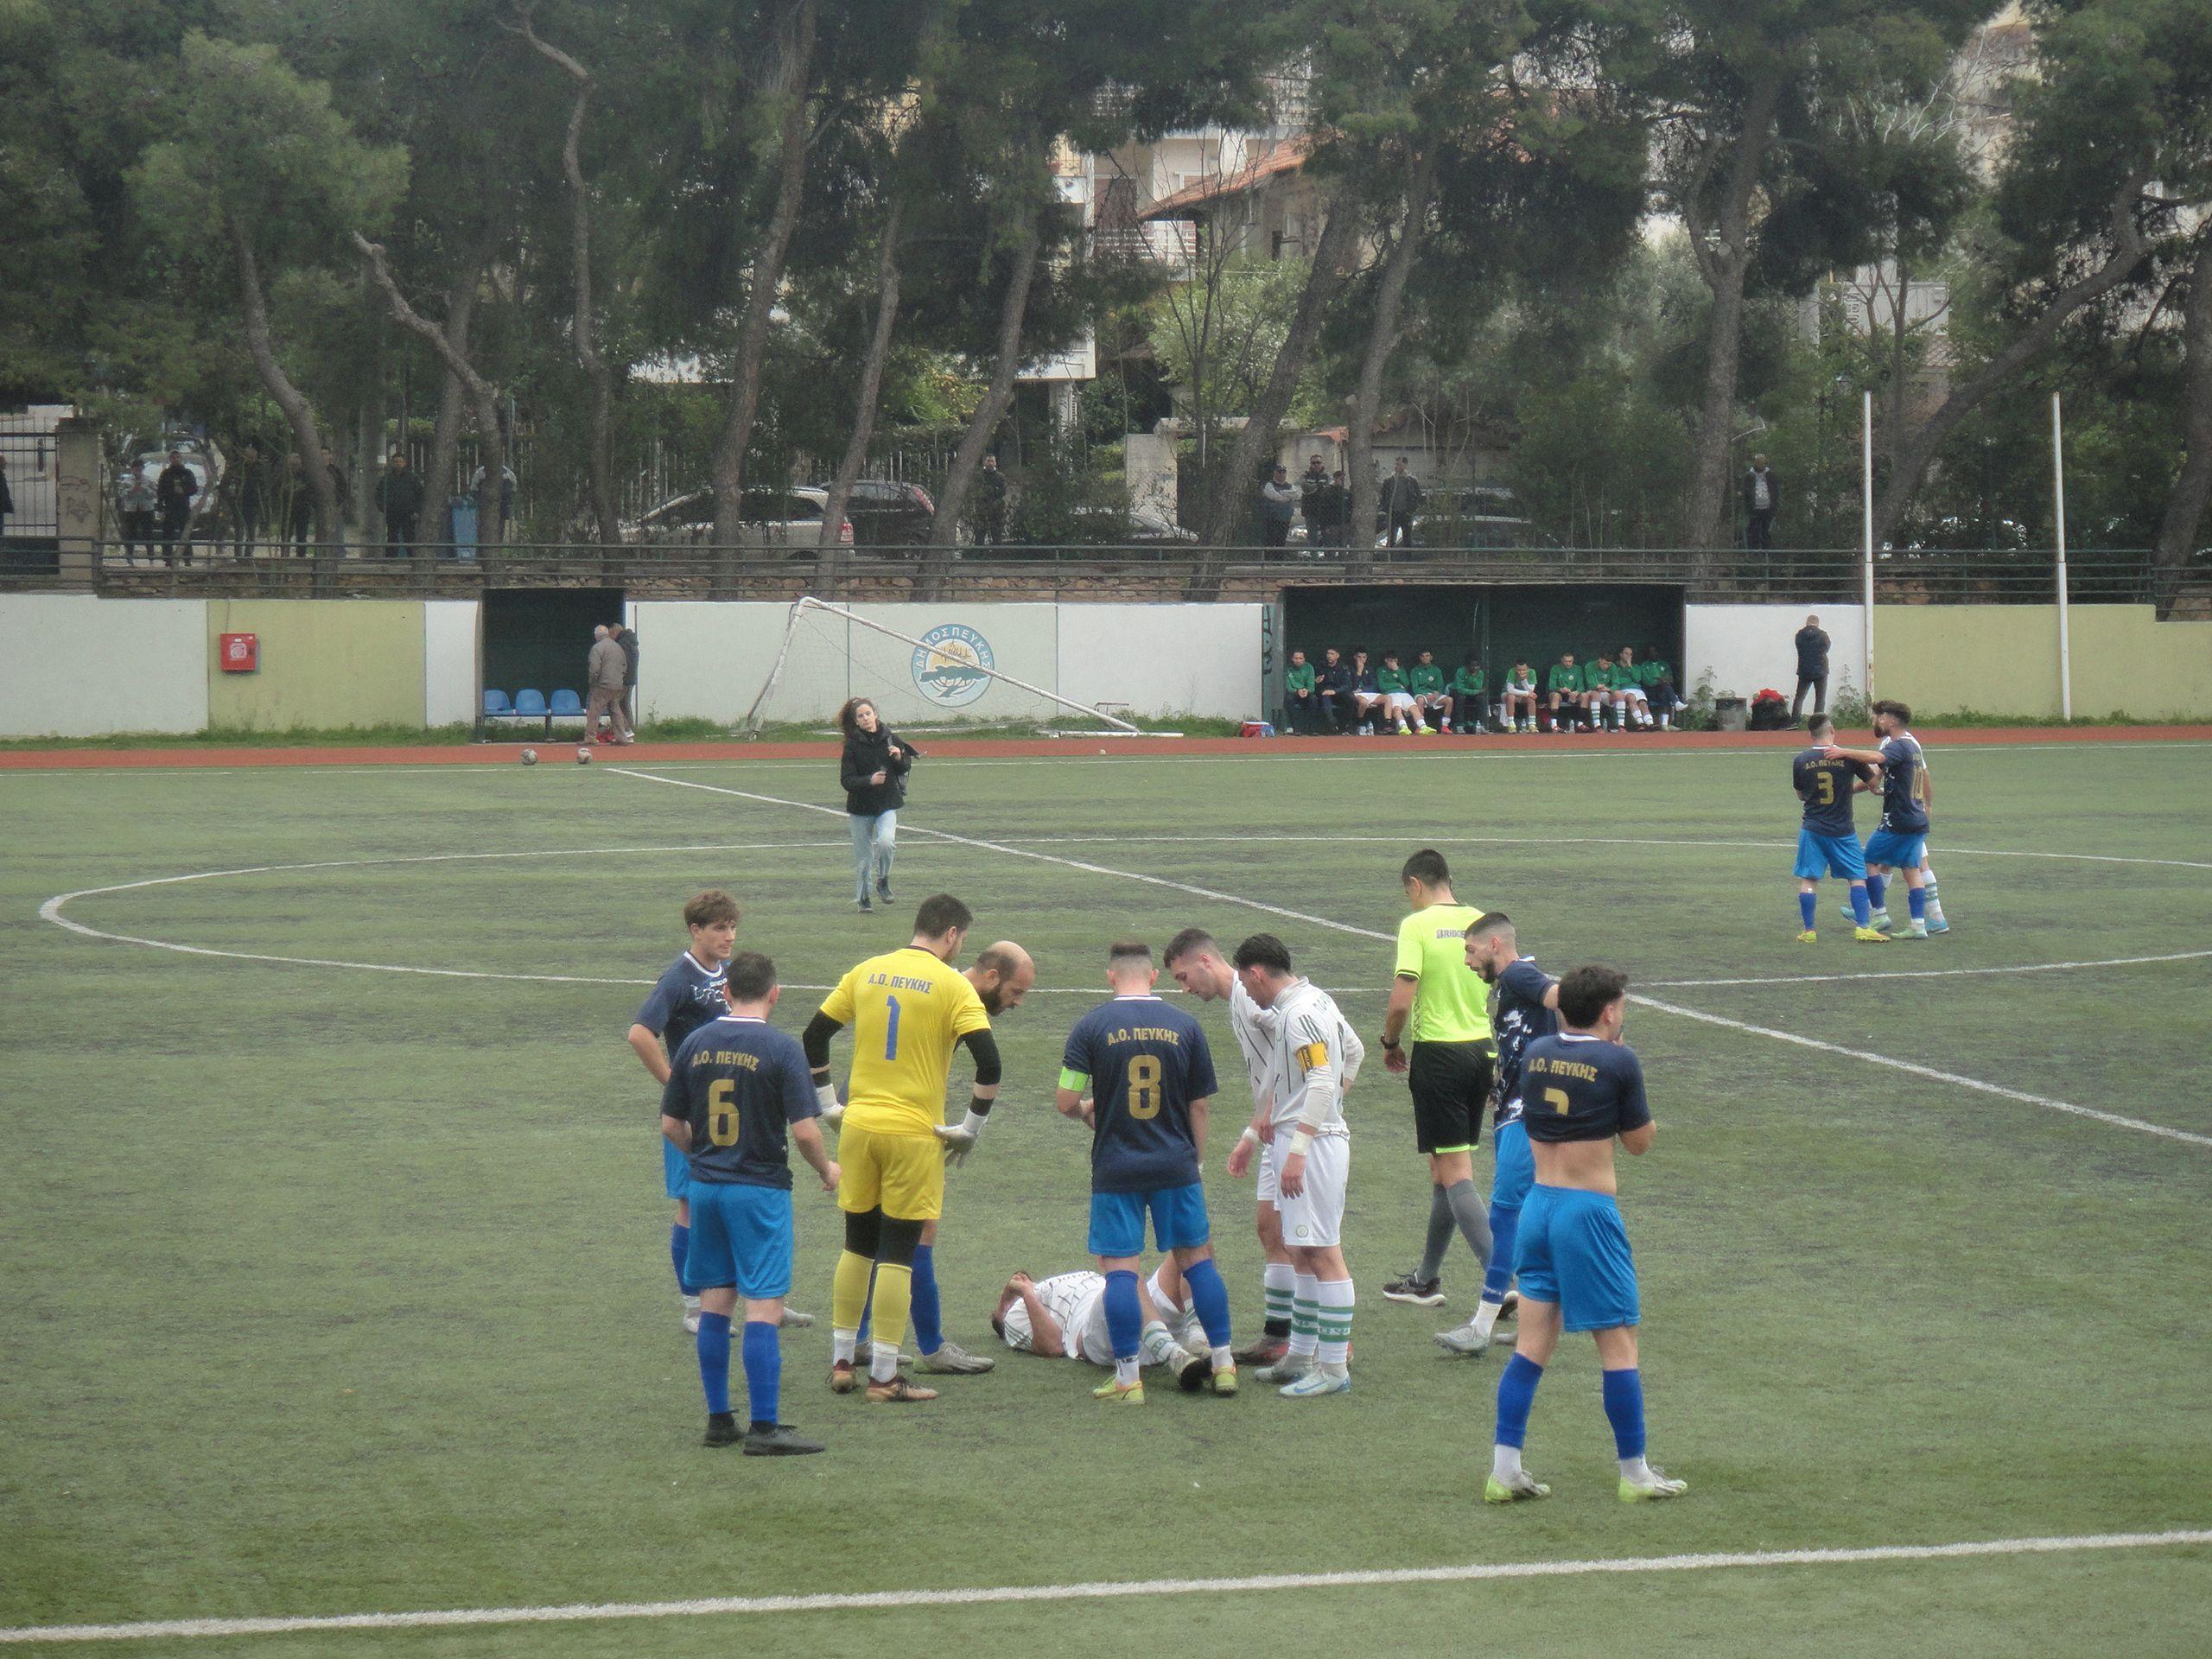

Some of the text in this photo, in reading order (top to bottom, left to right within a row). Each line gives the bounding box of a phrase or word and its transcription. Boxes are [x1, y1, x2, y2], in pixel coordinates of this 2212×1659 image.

[951, 626, 991, 668] ΠΕΥΚΗΣ
[1816, 771, 1834, 804] 3
[868, 973, 933, 995] Α.Ο. ΠΕΥΚΗΣ
[885, 995, 901, 1060] 1
[1108, 1027, 1180, 1046] Α.Ο. ΠΕΥΚΗΣ
[692, 1050, 760, 1072] Α.Ο. ΠΕΥΚΗΣ
[1550, 1059, 1599, 1083] ΠΕΥΚΗΣ
[1128, 1054, 1161, 1120] 8
[708, 1078, 740, 1147] 6
